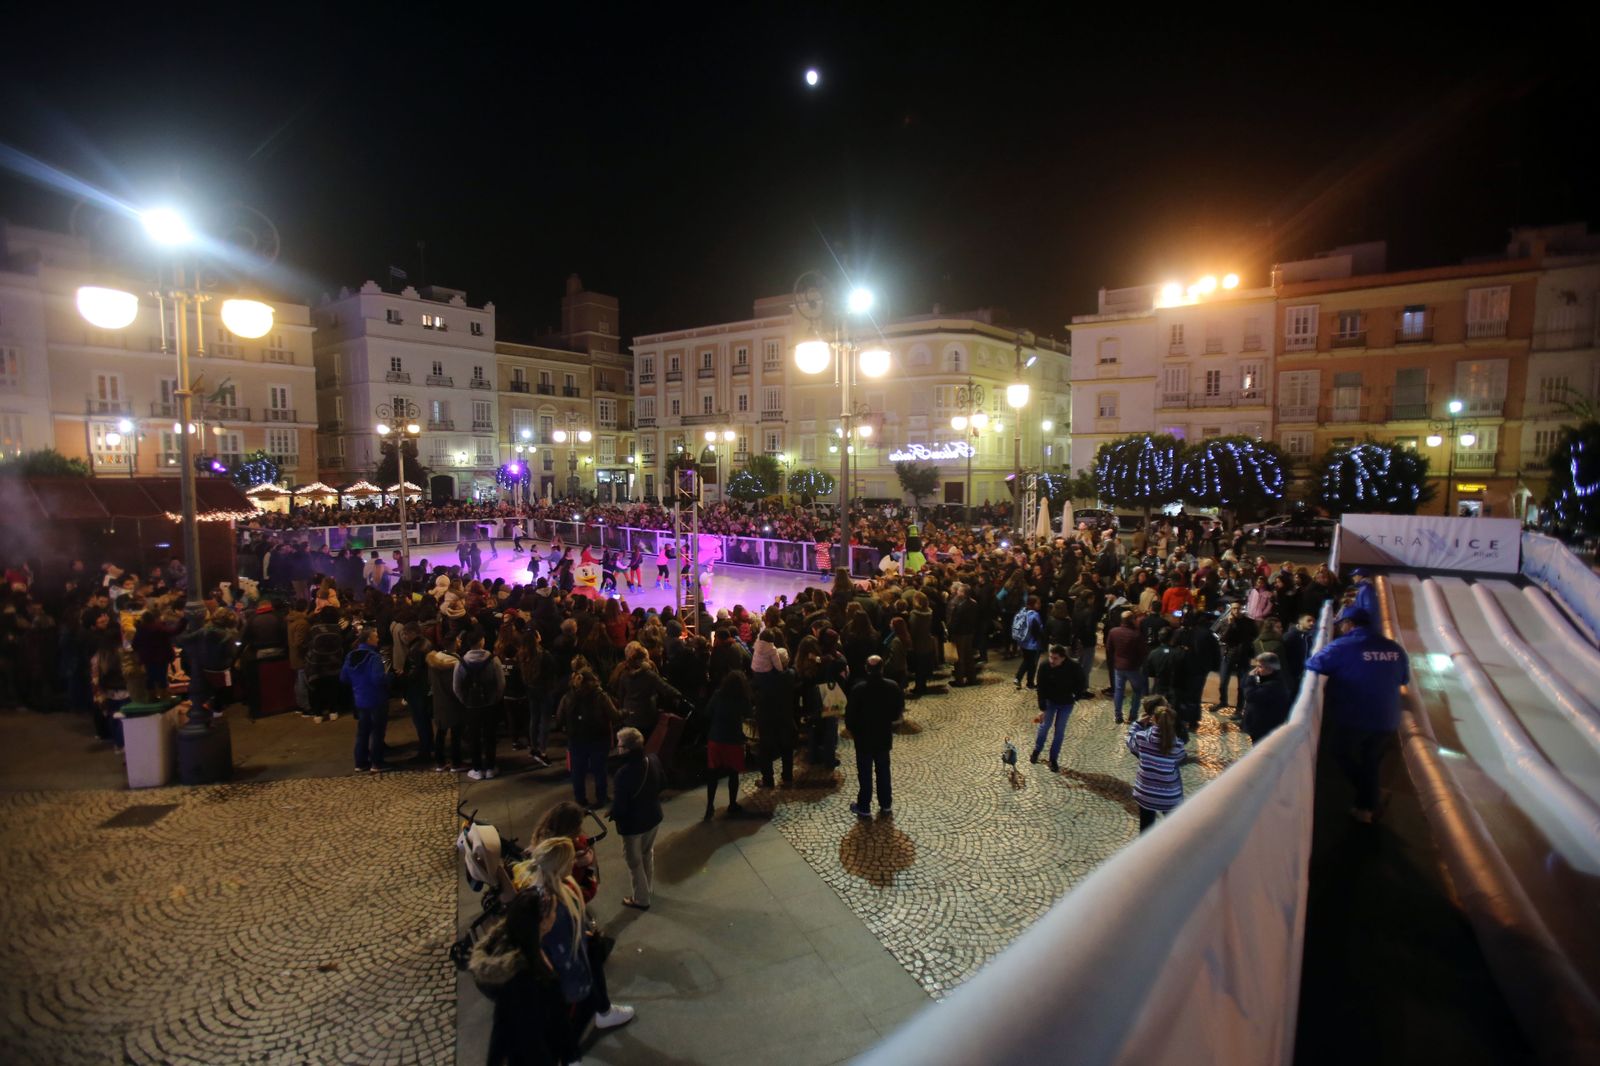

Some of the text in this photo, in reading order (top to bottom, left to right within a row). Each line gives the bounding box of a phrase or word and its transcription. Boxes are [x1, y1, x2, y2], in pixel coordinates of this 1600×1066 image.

[1360, 535, 1499, 550] XTRA ICE
[1362, 651, 1400, 661] STAFF
